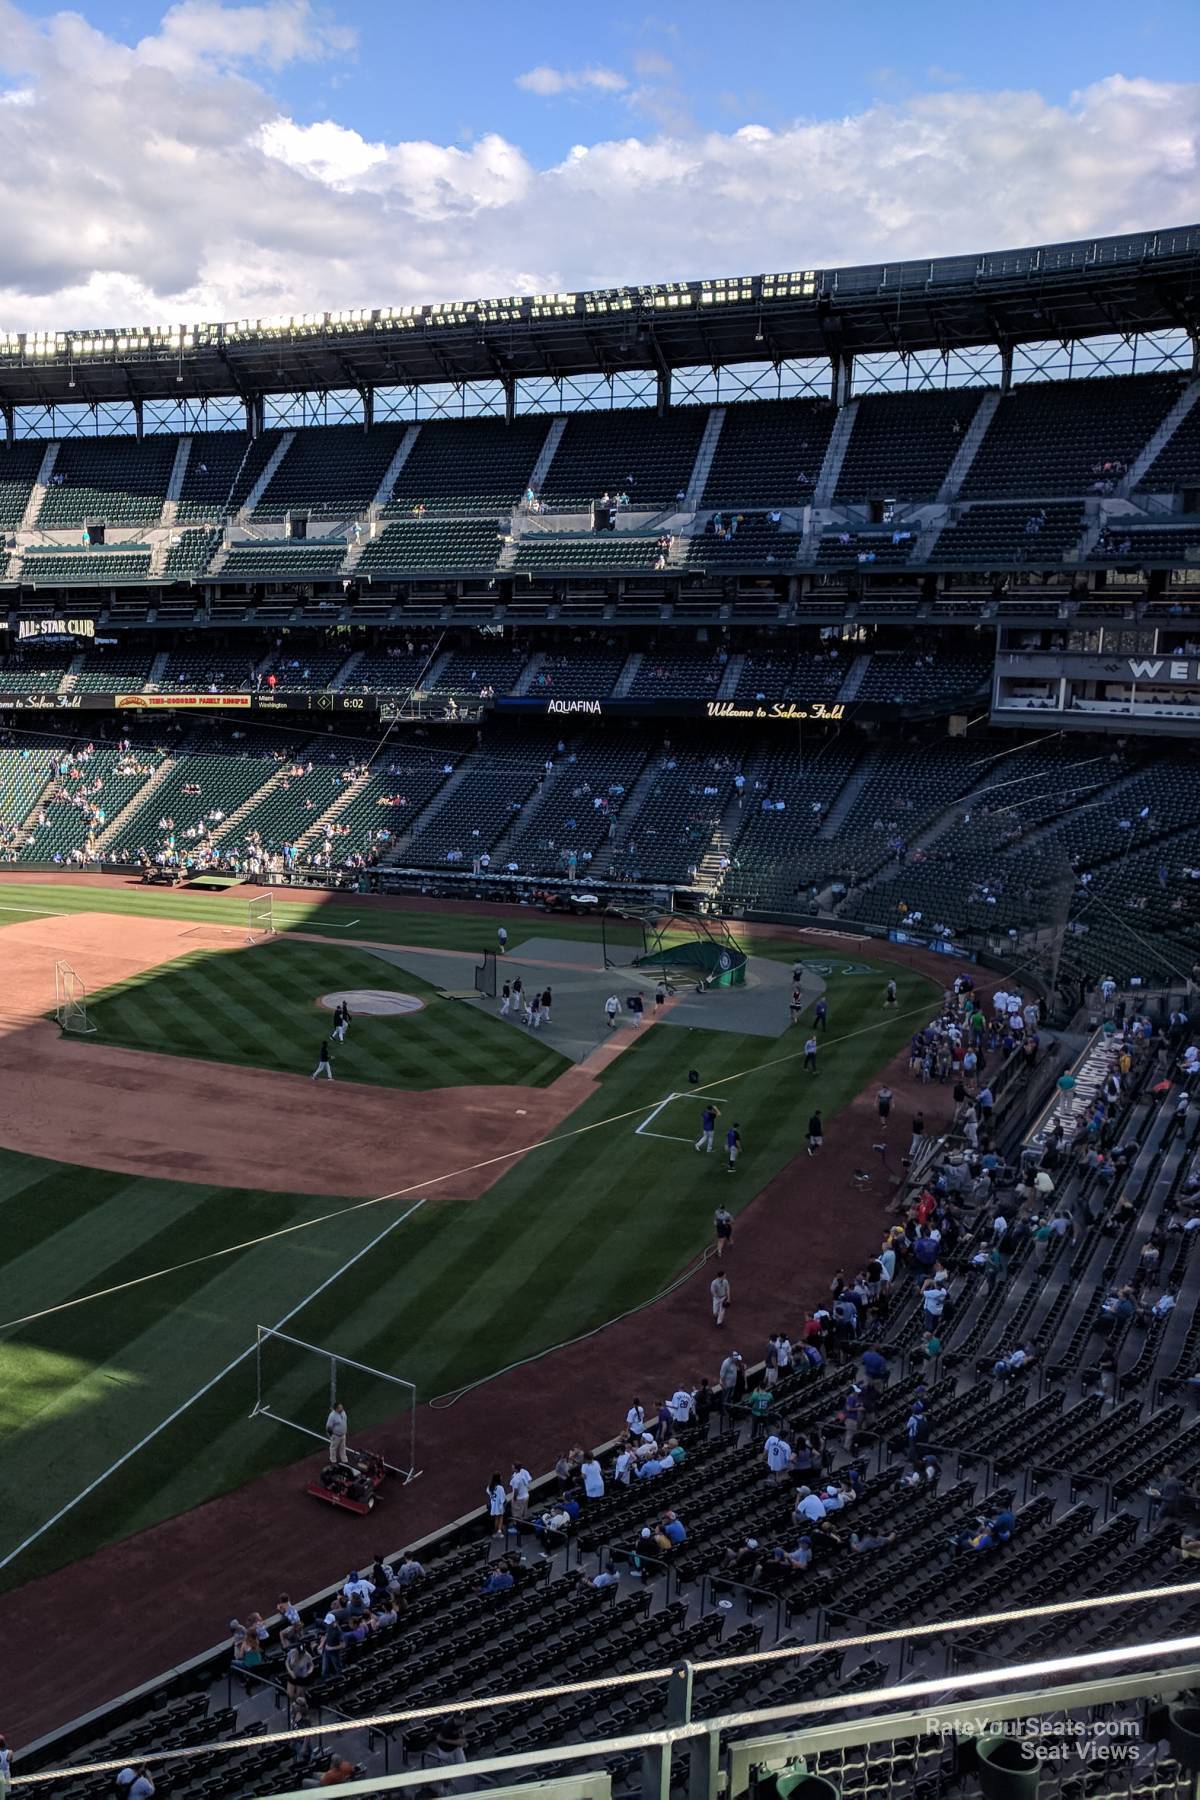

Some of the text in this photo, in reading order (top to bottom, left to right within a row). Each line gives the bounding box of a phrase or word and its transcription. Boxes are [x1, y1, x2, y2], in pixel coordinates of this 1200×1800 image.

[67, 619, 96, 638] CLUB
[1128, 658, 1200, 679] WE
[25, 696, 54, 709] Safeco
[56, 695, 82, 708] Field
[343, 698, 364, 709] 6:02
[548, 699, 602, 714] AQUAFINA
[707, 702, 845, 719] Welcome to Safeco Field
